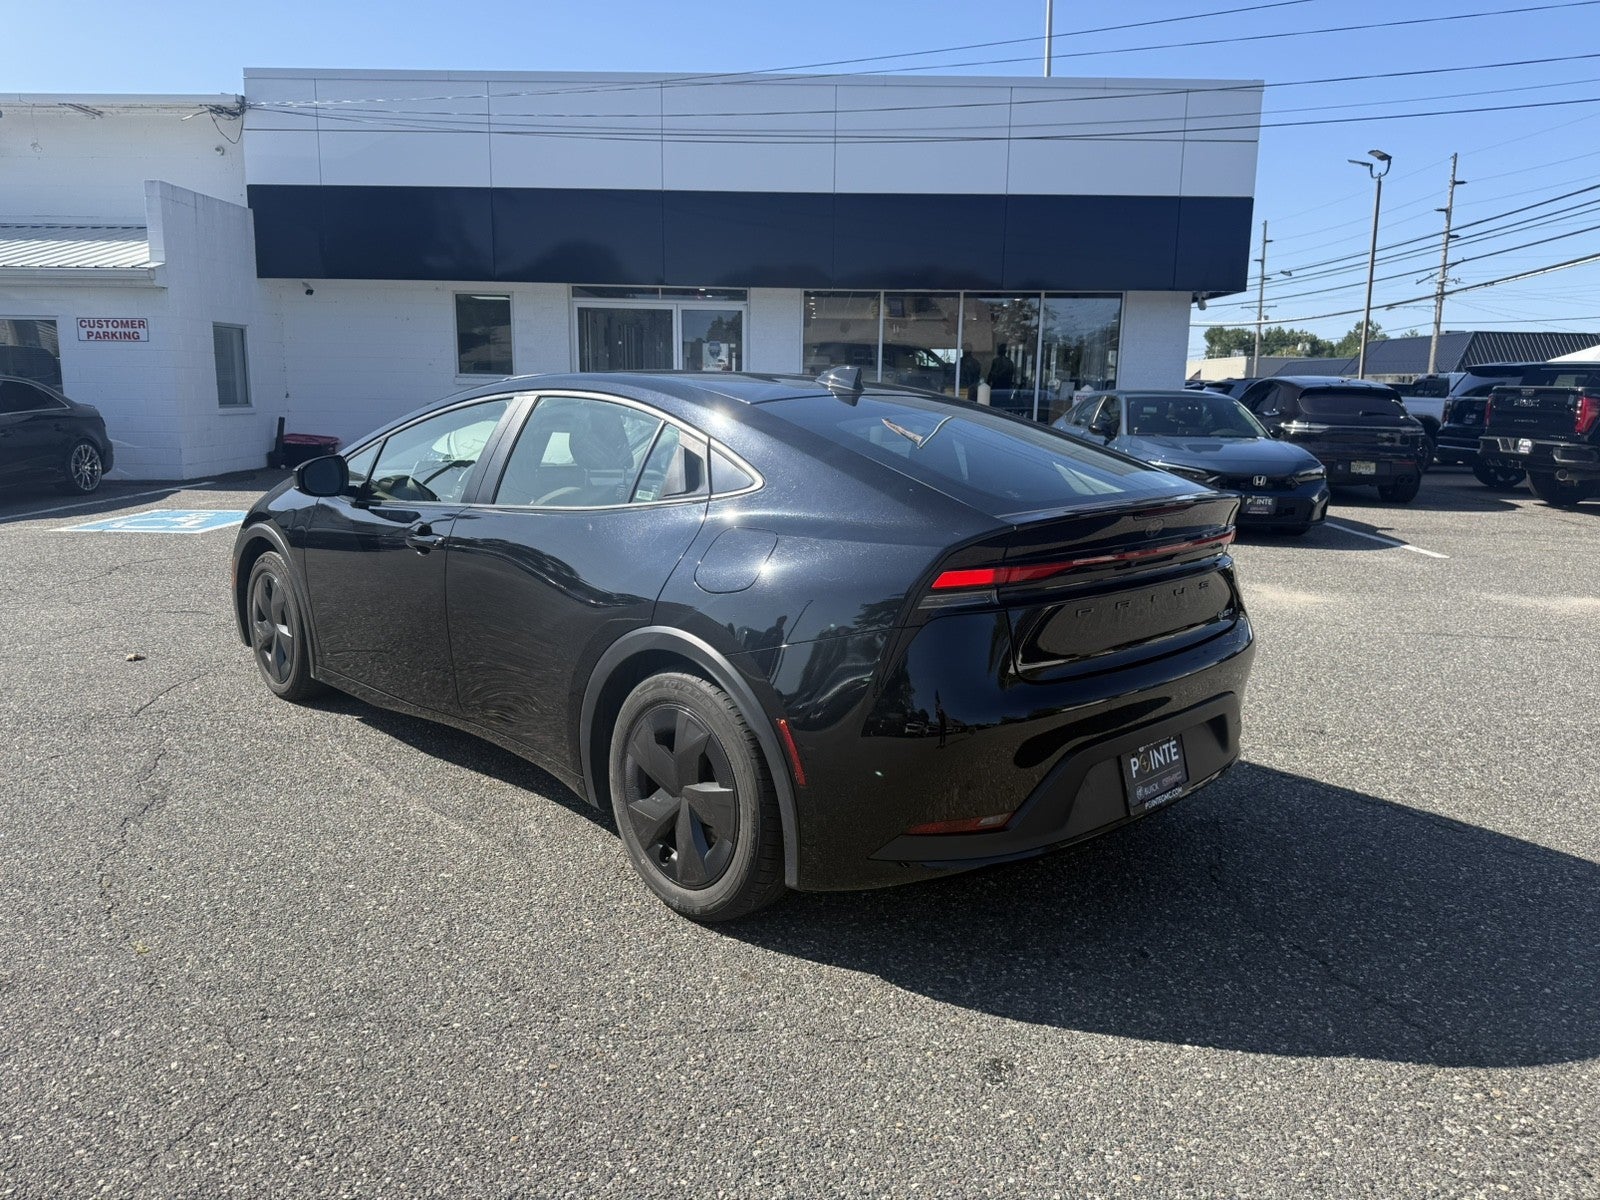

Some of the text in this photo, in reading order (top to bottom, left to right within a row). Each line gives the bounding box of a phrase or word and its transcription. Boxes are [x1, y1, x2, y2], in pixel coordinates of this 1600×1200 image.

[79, 320, 146, 329] CUSTOMER
[86, 331, 140, 340] PARKING
[1076, 580, 1209, 618] PRIUS
[1130, 740, 1179, 779] POINTE
